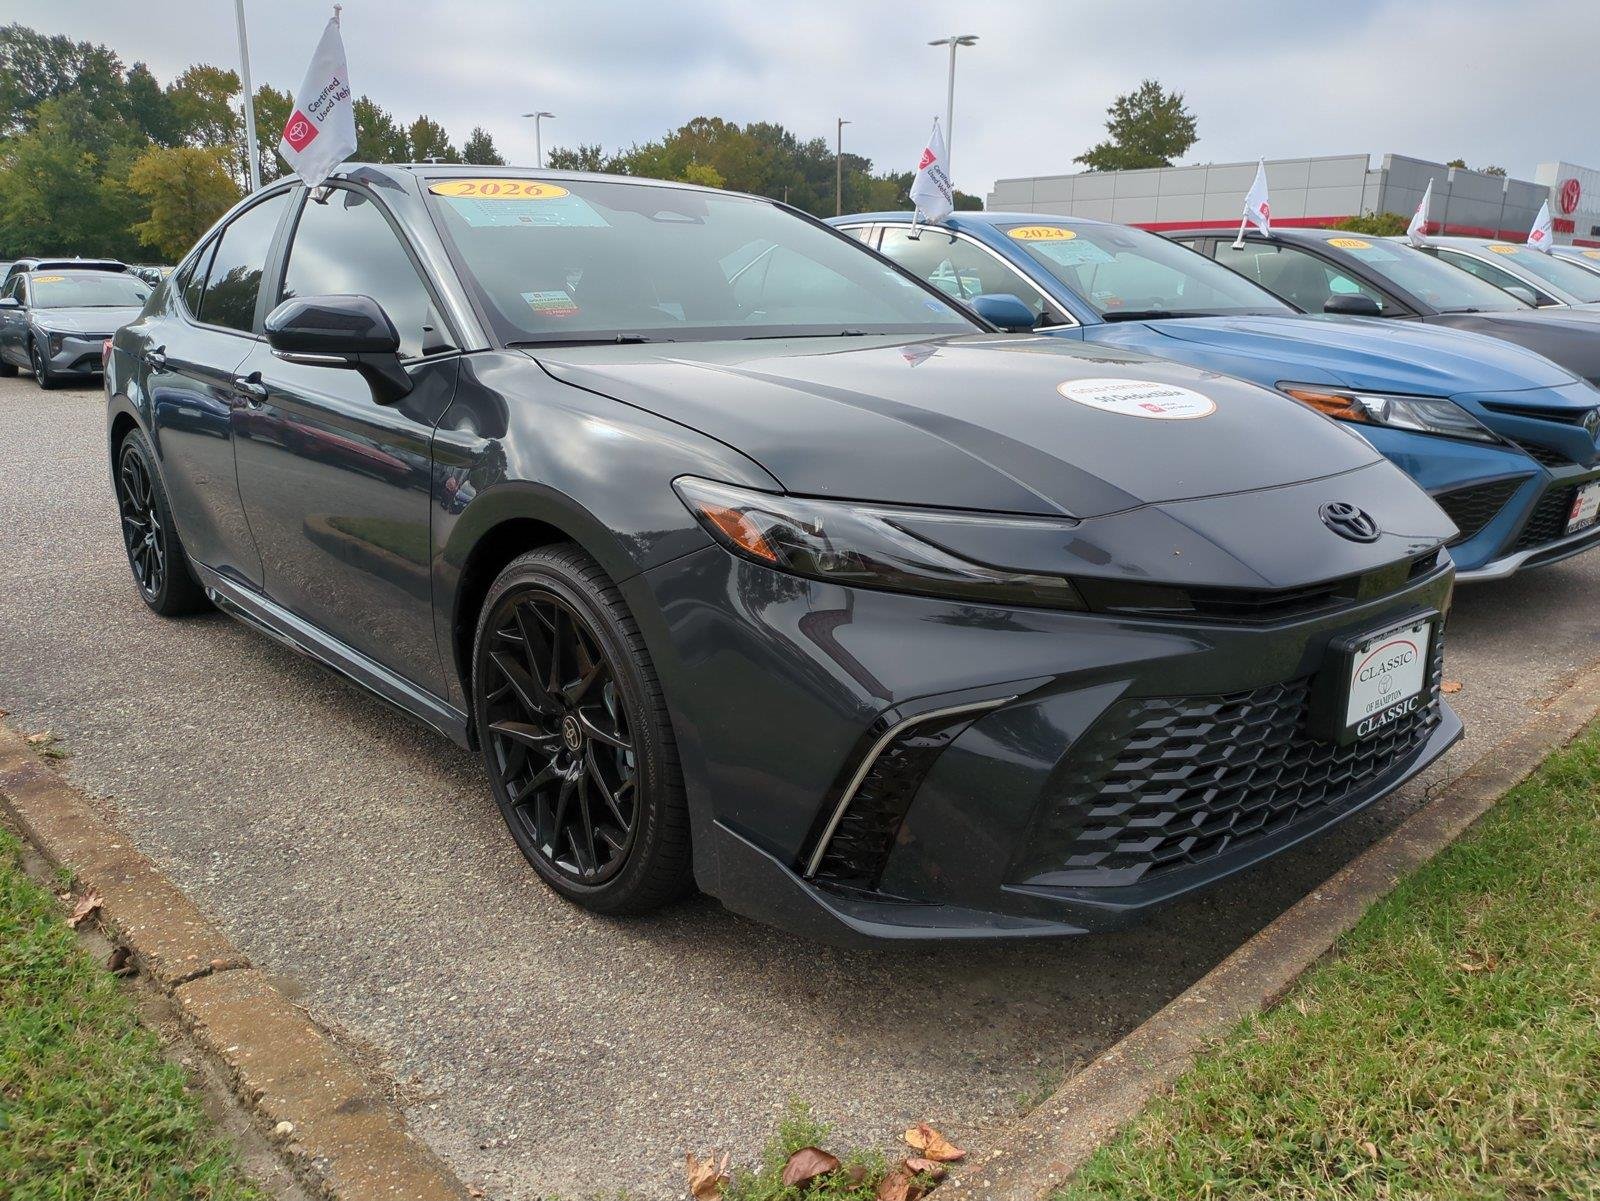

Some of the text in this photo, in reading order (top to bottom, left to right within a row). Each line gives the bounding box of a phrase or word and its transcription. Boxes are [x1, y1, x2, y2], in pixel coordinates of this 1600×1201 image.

[308, 77, 341, 113] Certified
[316, 99, 335, 122] Used
[459, 183, 543, 196] 2026
[1020, 229, 1064, 238] 2024
[1360, 651, 1413, 682] CLASSIC
[1365, 689, 1403, 713] OF HAMPTON
[1356, 696, 1420, 737] CLASSIC
